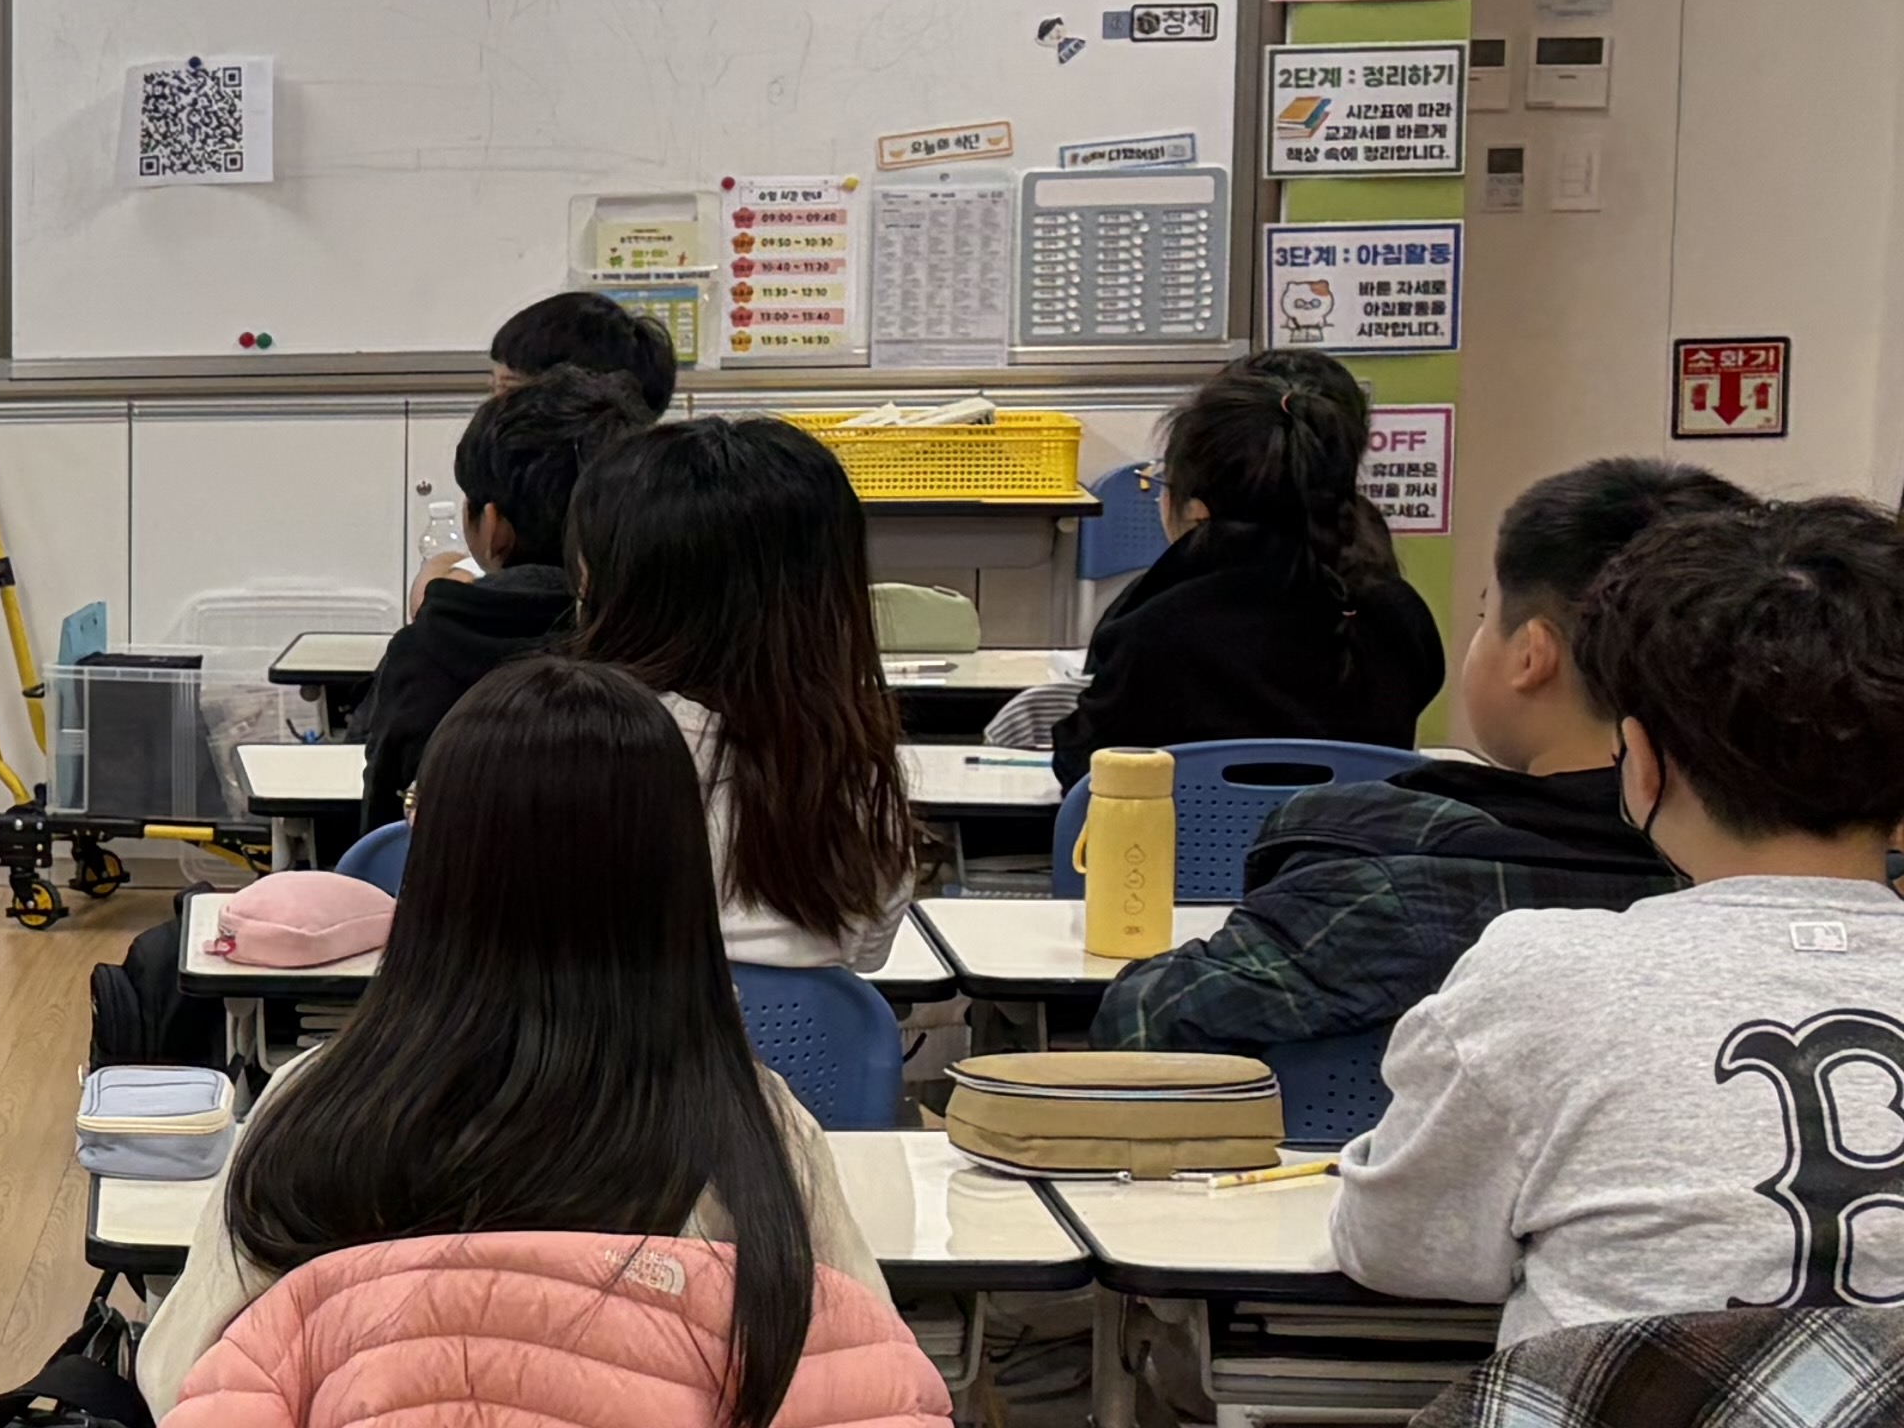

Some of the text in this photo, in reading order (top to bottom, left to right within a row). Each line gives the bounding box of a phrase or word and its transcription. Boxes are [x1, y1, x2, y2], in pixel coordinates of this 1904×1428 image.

[1278, 67, 1341, 89] 2단계
[1362, 64, 1454, 88] 정리하기
[1346, 102, 1453, 120] 시간표에 따라
[1324, 124, 1447, 141] 교과서를 바르게
[1286, 147, 1320, 163] 책상
[1363, 145, 1450, 162] 정리합니다.
[761, 212, 793, 222] 09:00
[1275, 245, 1337, 267] 3단계
[1357, 243, 1452, 266] 아침활동
[1359, 280, 1447, 297] 바른 자세로
[1363, 301, 1446, 316] 아침활동을
[1357, 322, 1445, 337] 시작합니다.
[1688, 349, 1775, 366] 소화기
[1368, 430, 1427, 452] OFF
[1372, 461, 1438, 478] 휴대폰은
